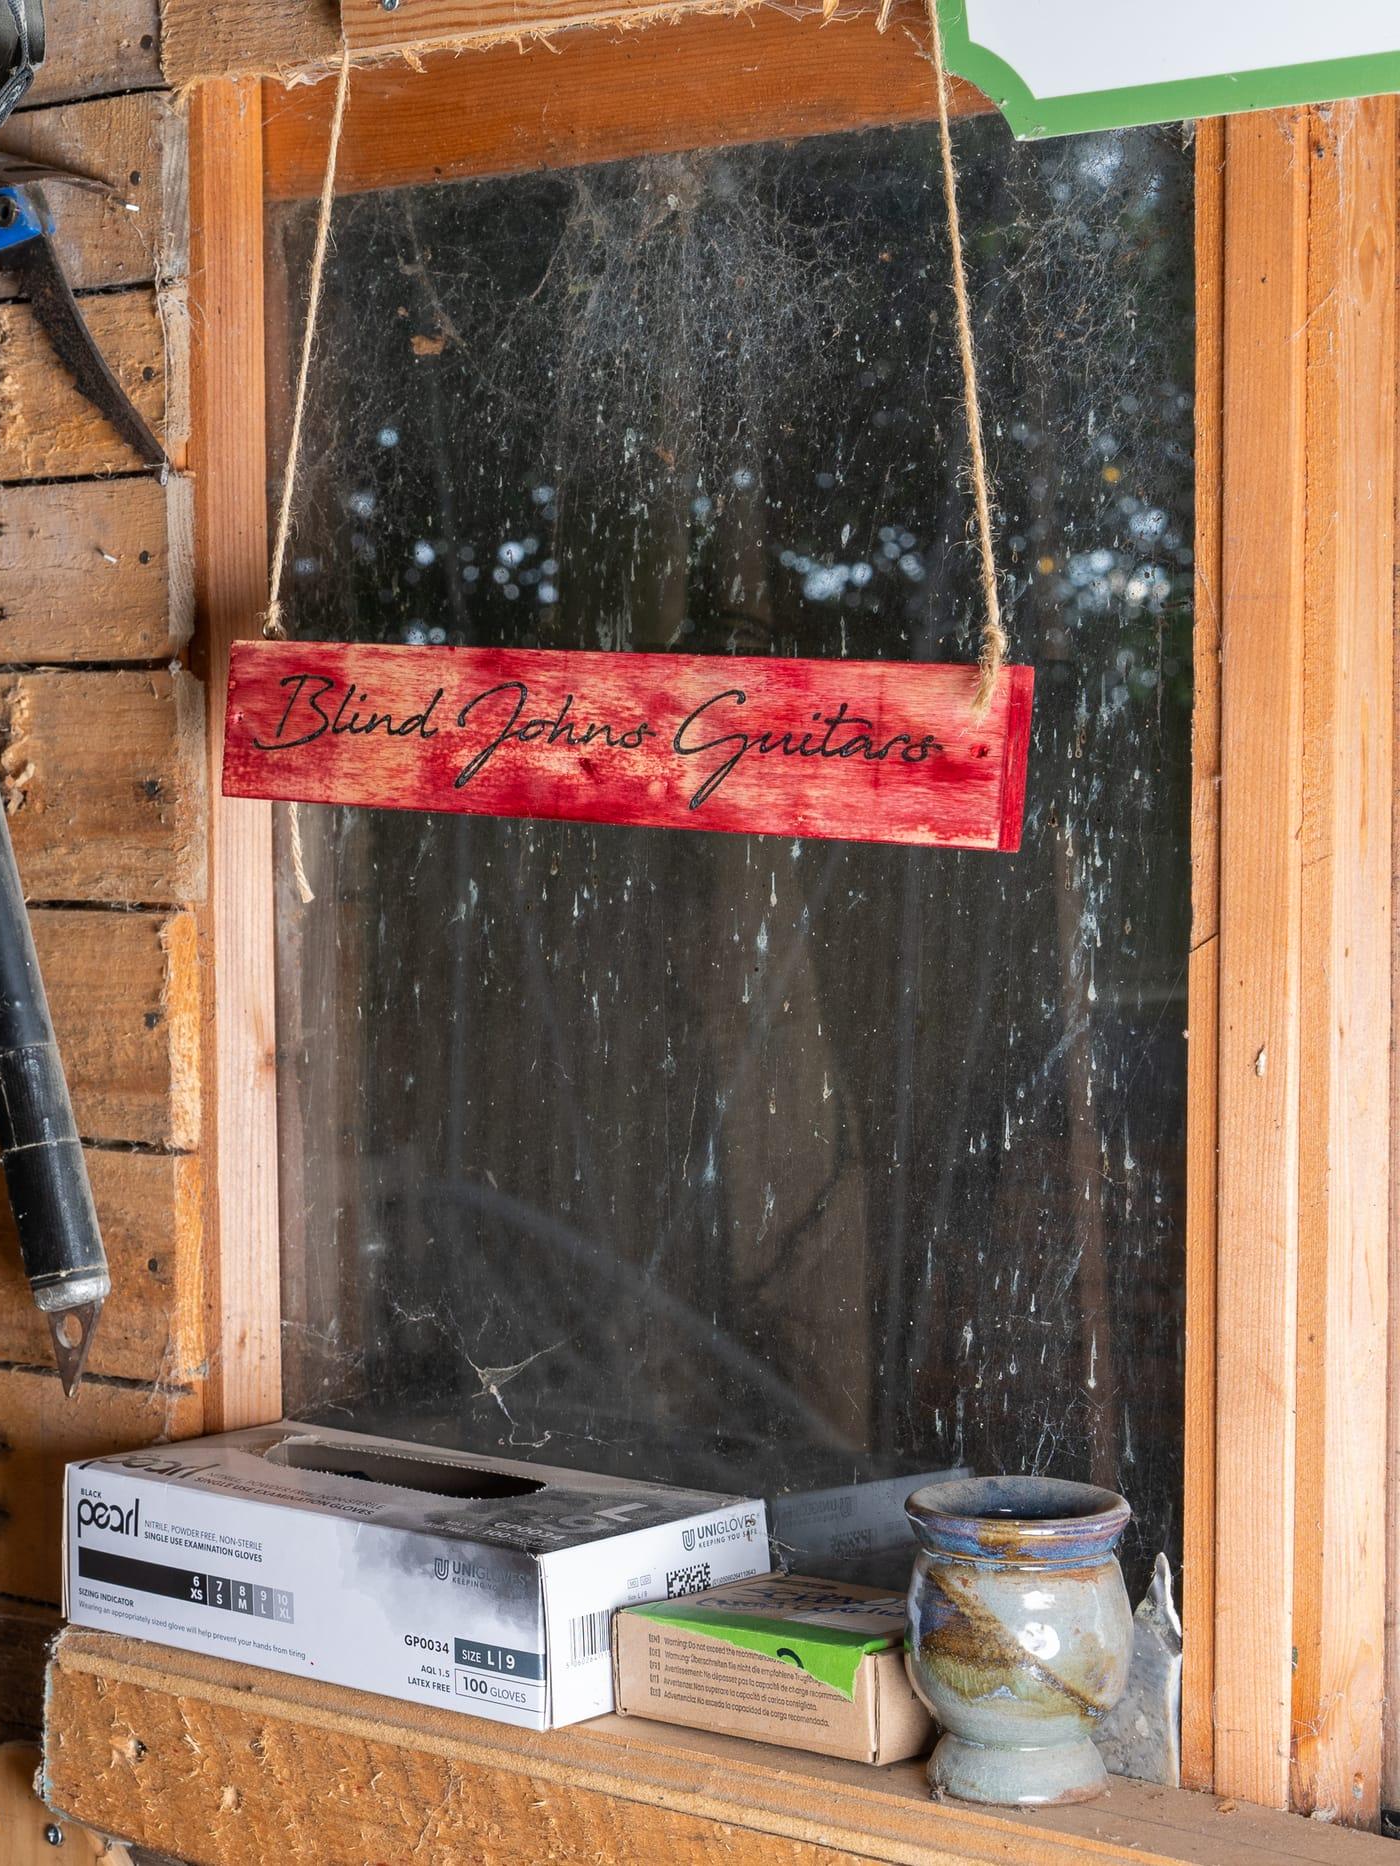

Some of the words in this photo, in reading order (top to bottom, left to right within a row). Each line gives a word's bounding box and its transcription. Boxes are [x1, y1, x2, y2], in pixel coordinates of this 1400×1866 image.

[253, 673, 443, 751] Blind
[455, 681, 658, 789] Johns
[673, 688, 944, 811] Guitars
[80, 1488, 102, 1499] BLACK
[193, 1476, 233, 1489] SINGLE
[232, 1484, 255, 1493] USE
[254, 1488, 330, 1507] EXAMINATION
[329, 1502, 375, 1516] GLOVES
[77, 1498, 140, 1538] pearl
[144, 1519, 169, 1533] NITRILE,
[171, 1525, 199, 1538] POWDER
[200, 1530, 217, 1543] FREE,
[219, 1534, 262, 1551] NON-STERILE
[483, 1529, 511, 1538] 100
[494, 1521, 566, 1541] GP0034
[698, 1535, 725, 1548] KEEPING
[727, 1531, 741, 1541] YOU
[144, 1531, 168, 1543] SINGLE
[169, 1535, 183, 1546] USE
[183, 1539, 233, 1557] EXAMINATION
[233, 1548, 263, 1563] GLOVES
[78, 1587, 99, 1599] SIZING
[100, 1592, 135, 1608] INDICATOR
[192, 1575, 200, 1587] 6
[215, 1579, 223, 1592] 7
[238, 1584, 246, 1597] 8
[259, 1589, 267, 1601] 9
[277, 1593, 288, 1606] 10
[190, 1587, 203, 1601] XS
[216, 1592, 223, 1605] S
[237, 1598, 247, 1610] M
[260, 1602, 266, 1614] L
[279, 1606, 291, 1619] XL
[79, 1600, 102, 1613] Wearing
[103, 1606, 110, 1614] an
[111, 1609, 150, 1625] appropriately
[151, 1617, 167, 1628] sized
[167, 1620, 185, 1632] glove
[186, 1625, 197, 1634] will
[197, 1627, 211, 1640] help
[212, 1631, 237, 1643] prevent
[237, 1637, 251, 1646] your
[251, 1639, 271, 1651] hands
[272, 1643, 287, 1655] from
[287, 1647, 306, 1660] tiring
[404, 1634, 449, 1654] GP0034
[461, 1649, 482, 1663] SIZE
[420, 1664, 437, 1676] AQL
[438, 1667, 450, 1678] 1.5
[407, 1676, 431, 1689] LATEX
[432, 1682, 451, 1693] FREE
[462, 1676, 488, 1695] 100
[489, 1687, 527, 1703] GLOVES
[780, 1684, 788, 1692] de
[770, 1709, 788, 1722] carga
